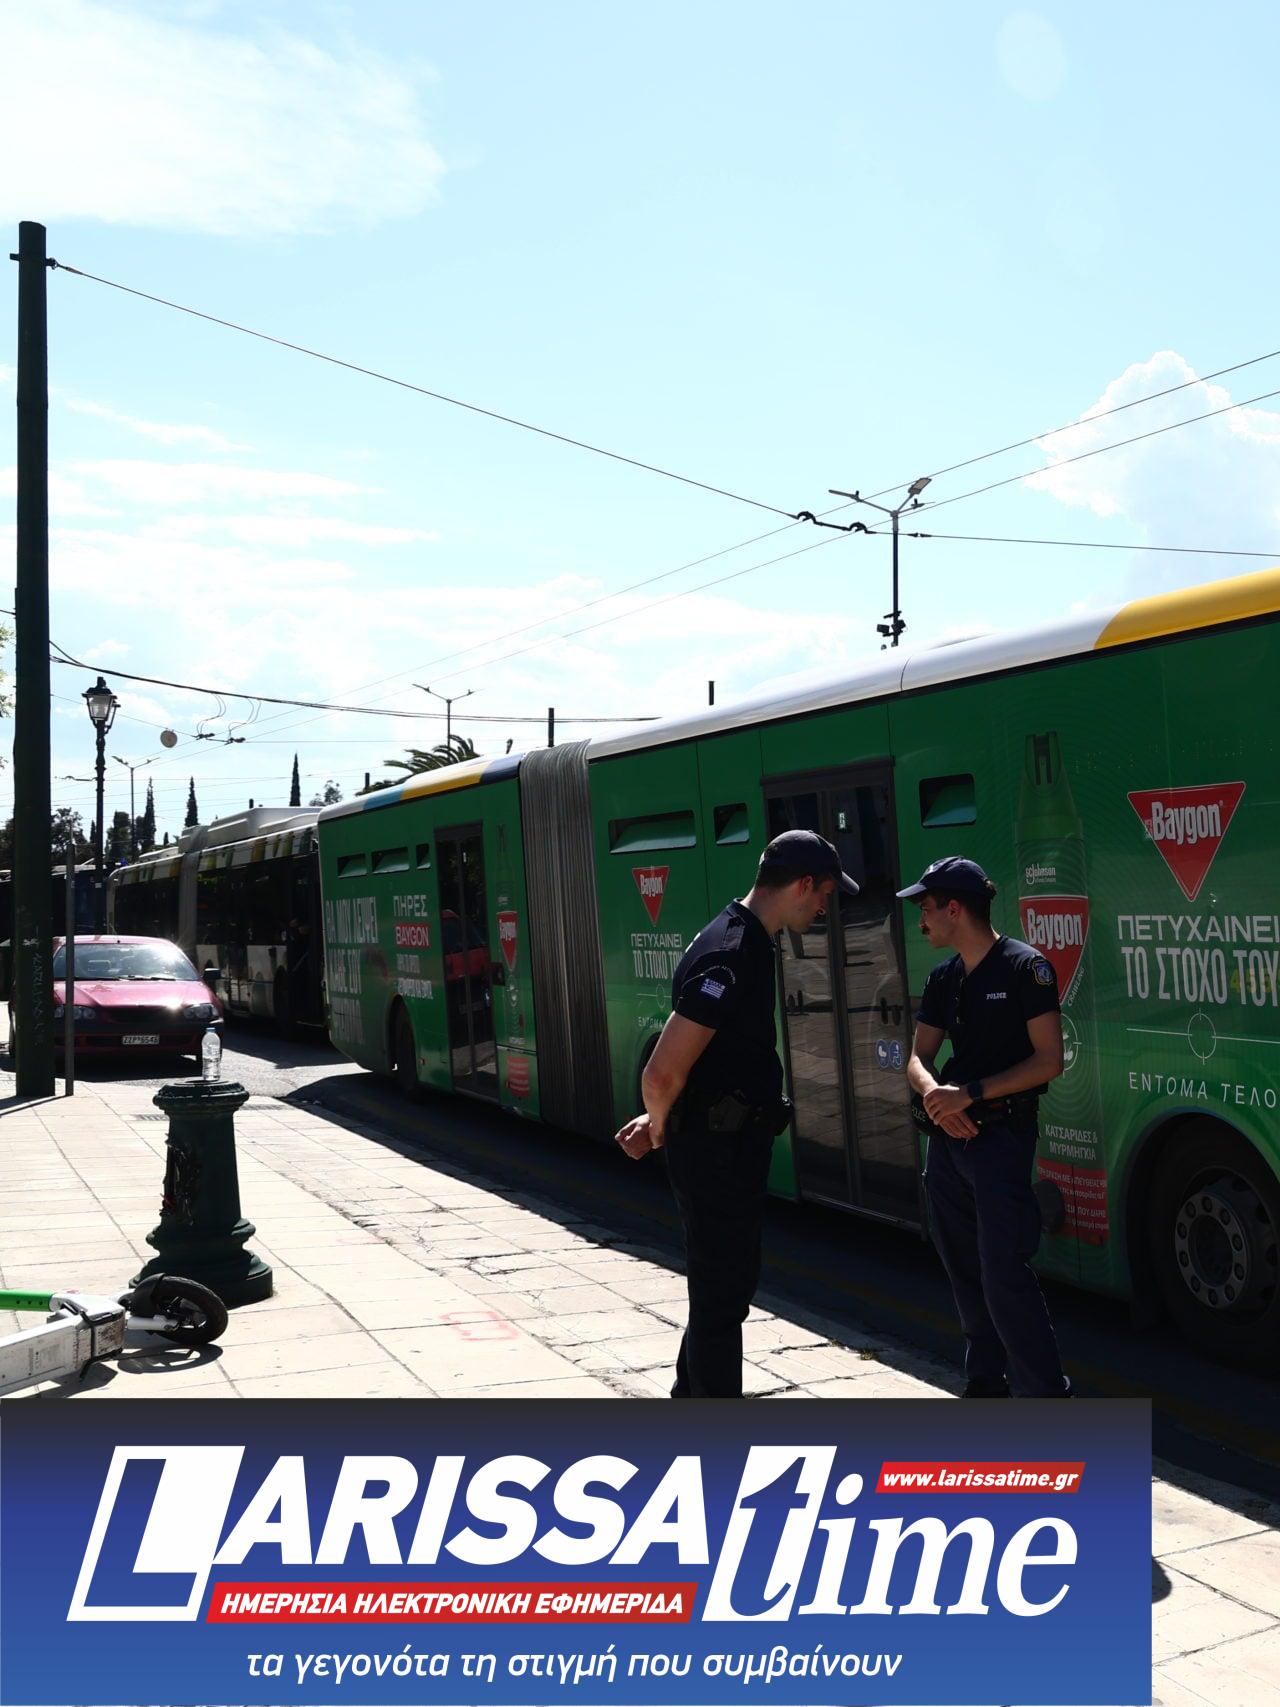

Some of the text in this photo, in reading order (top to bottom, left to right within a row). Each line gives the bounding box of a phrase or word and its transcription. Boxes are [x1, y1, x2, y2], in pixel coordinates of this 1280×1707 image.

[1151, 801, 1221, 846] Baygon
[640, 875, 664, 897] Baygon
[395, 926, 429, 946] BAYGON
[1027, 907, 1083, 950] Baygon
[1117, 915, 1280, 943] ΠΕΤΥΧΑΙΝΕΙ
[1120, 946, 1280, 1007] ΤΟ ΣΤΟΧΟ ΤΟΥ
[1128, 1072, 1208, 1100] ΕΝΤΟΜΑ
[1045, 1124, 1092, 1144] ΚΑΤΣΑΡΙΔΕΣ
[1049, 1141, 1097, 1161] ΜΥΡΜΗΓΚΙΑ
